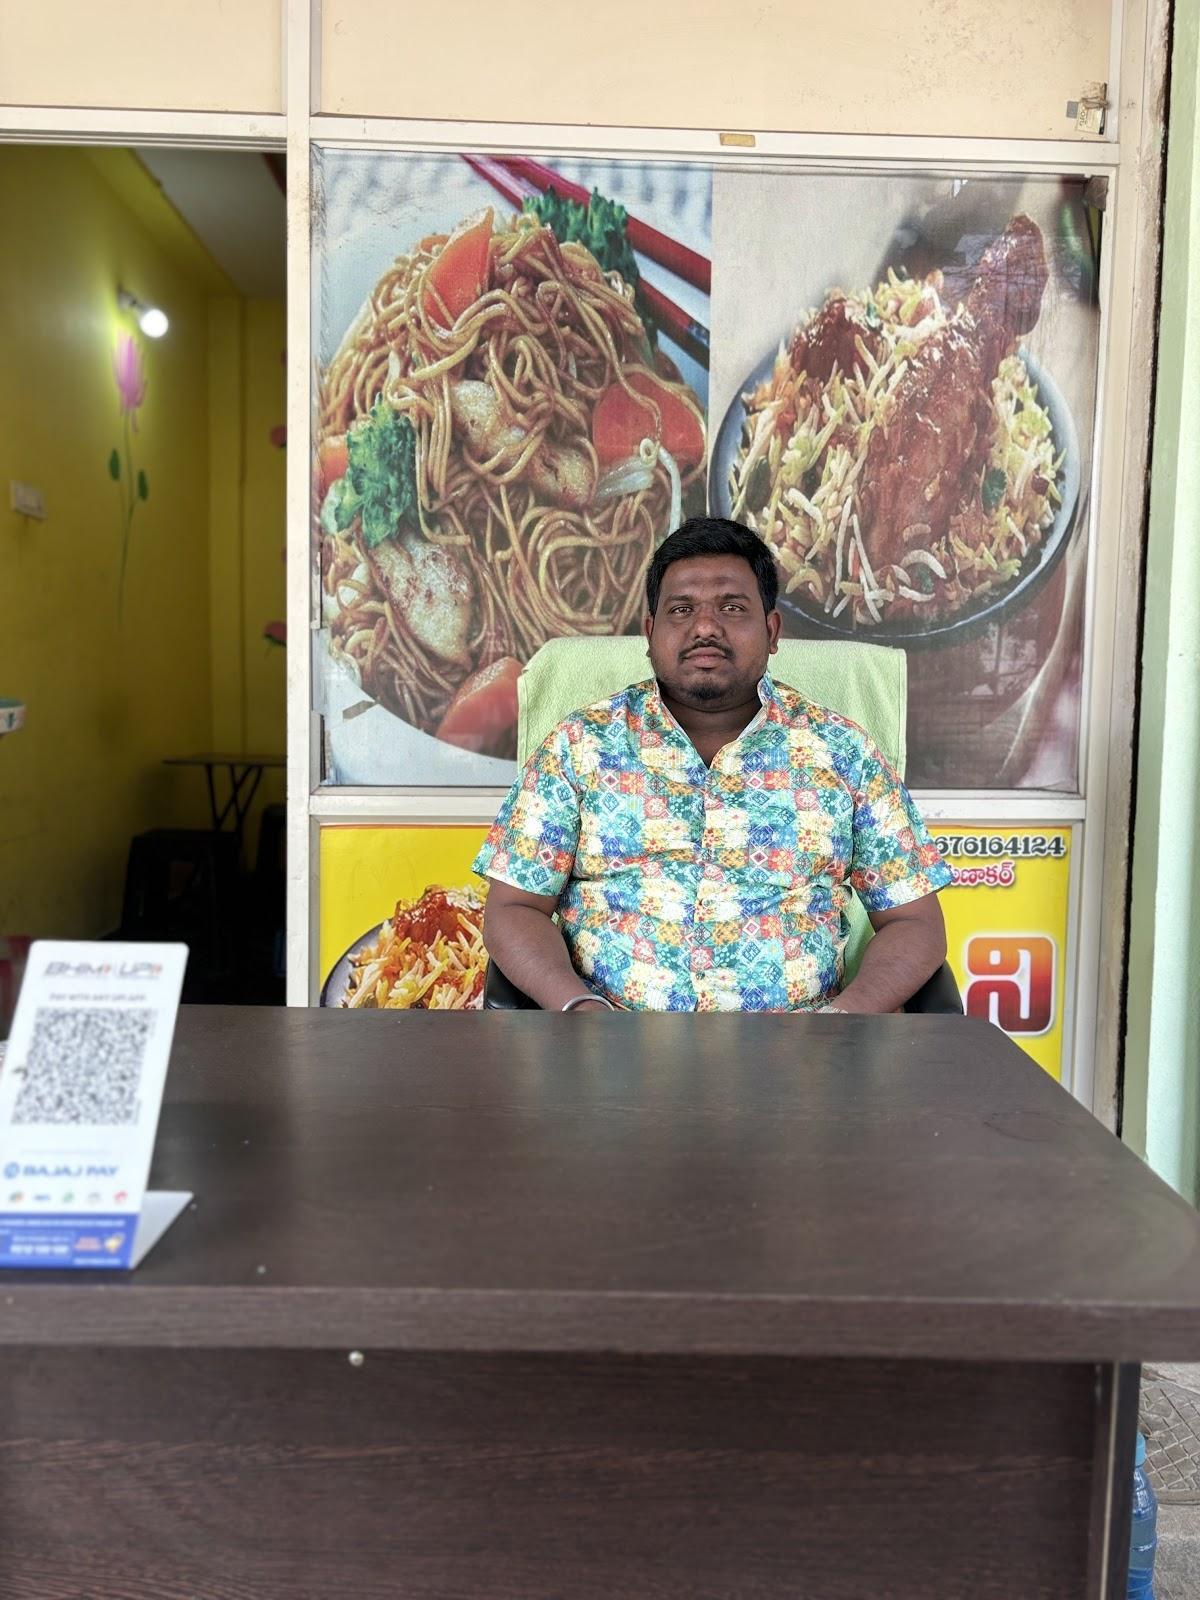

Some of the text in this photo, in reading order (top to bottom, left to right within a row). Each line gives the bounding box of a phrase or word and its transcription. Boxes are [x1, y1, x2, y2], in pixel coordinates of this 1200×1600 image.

[935, 836, 1064, 855] 676164124
[22, 1165, 119, 1177] BAJAJ PAY
